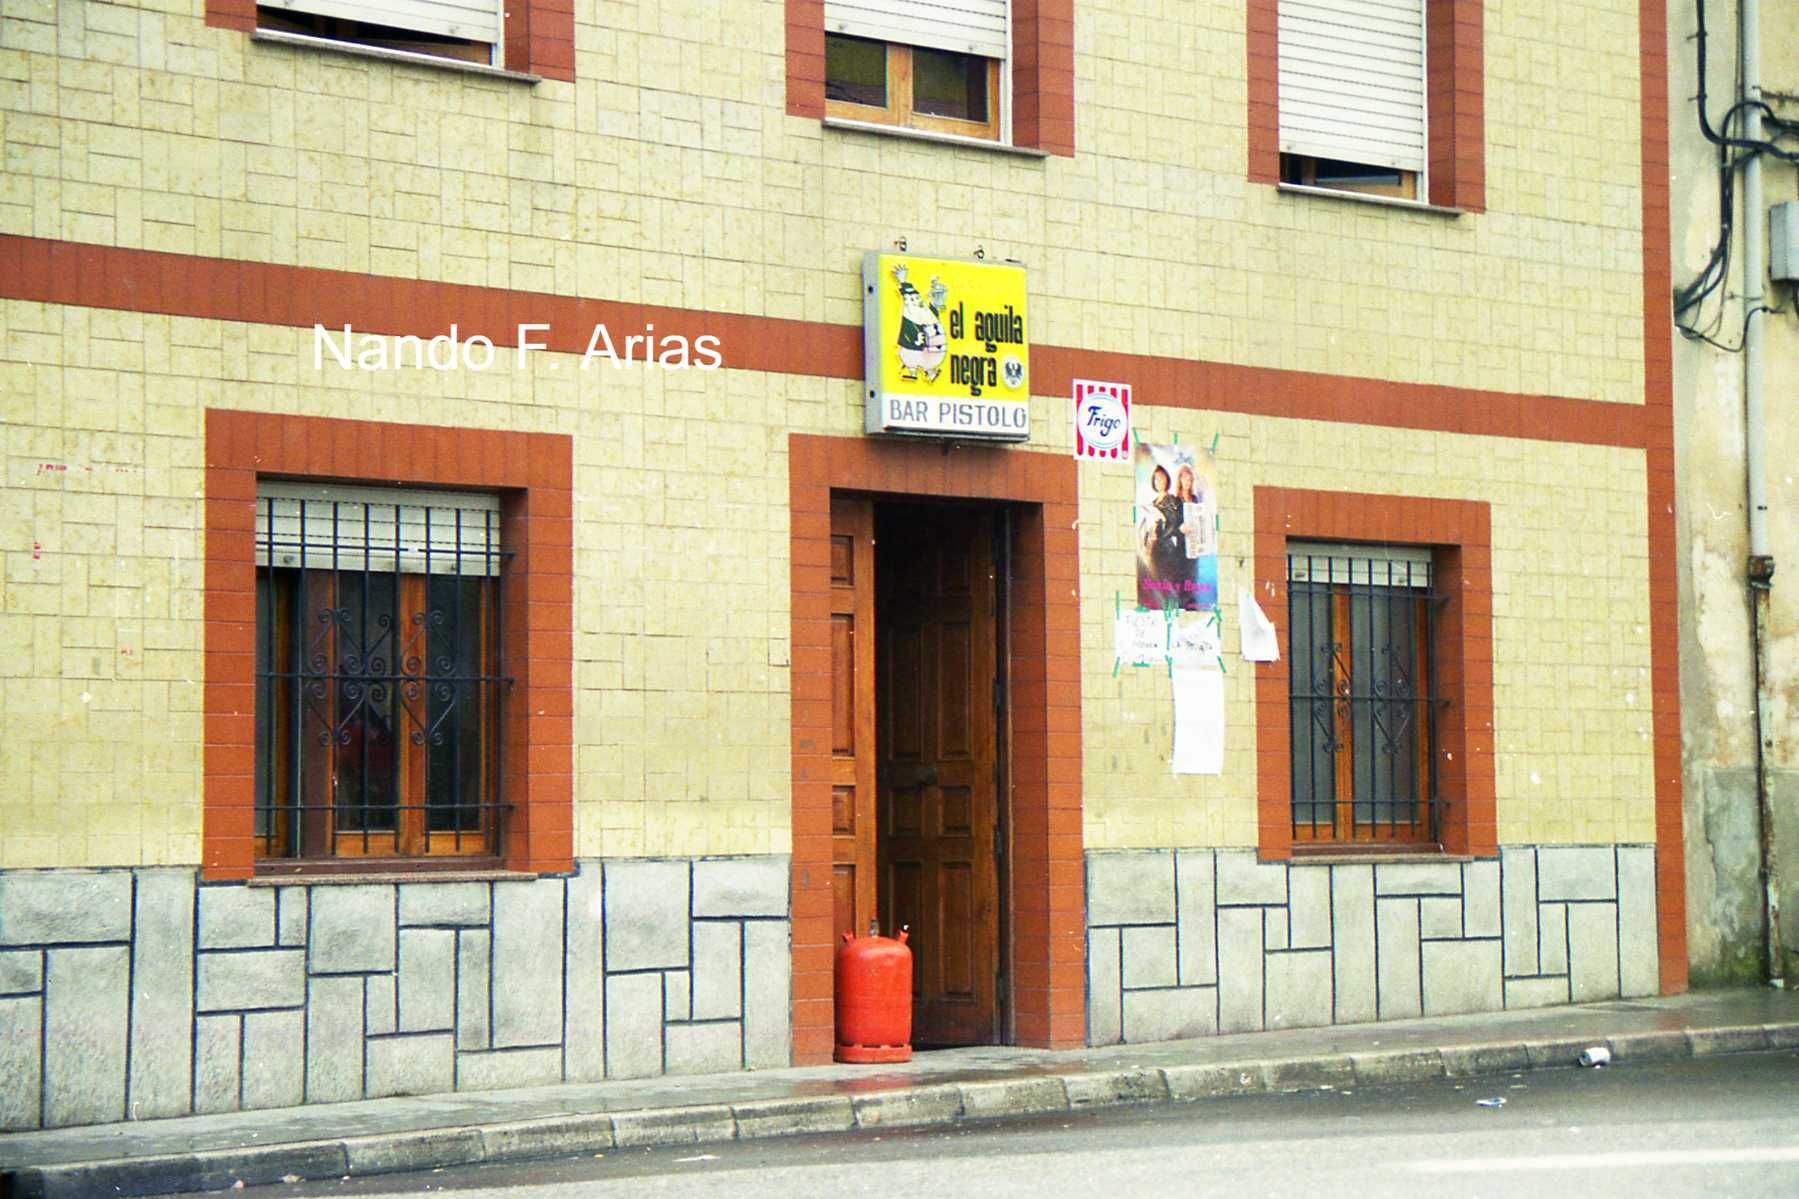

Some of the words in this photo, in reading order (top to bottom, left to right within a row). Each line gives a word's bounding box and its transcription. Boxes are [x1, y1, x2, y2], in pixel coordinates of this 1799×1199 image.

[950, 301, 964, 339] el
[975, 304, 1024, 353] aguila
[950, 354, 997, 396] negra
[890, 399, 928, 422] BAR
[939, 402, 1026, 428] PISTOLO
[1086, 405, 1121, 437] Frigo
